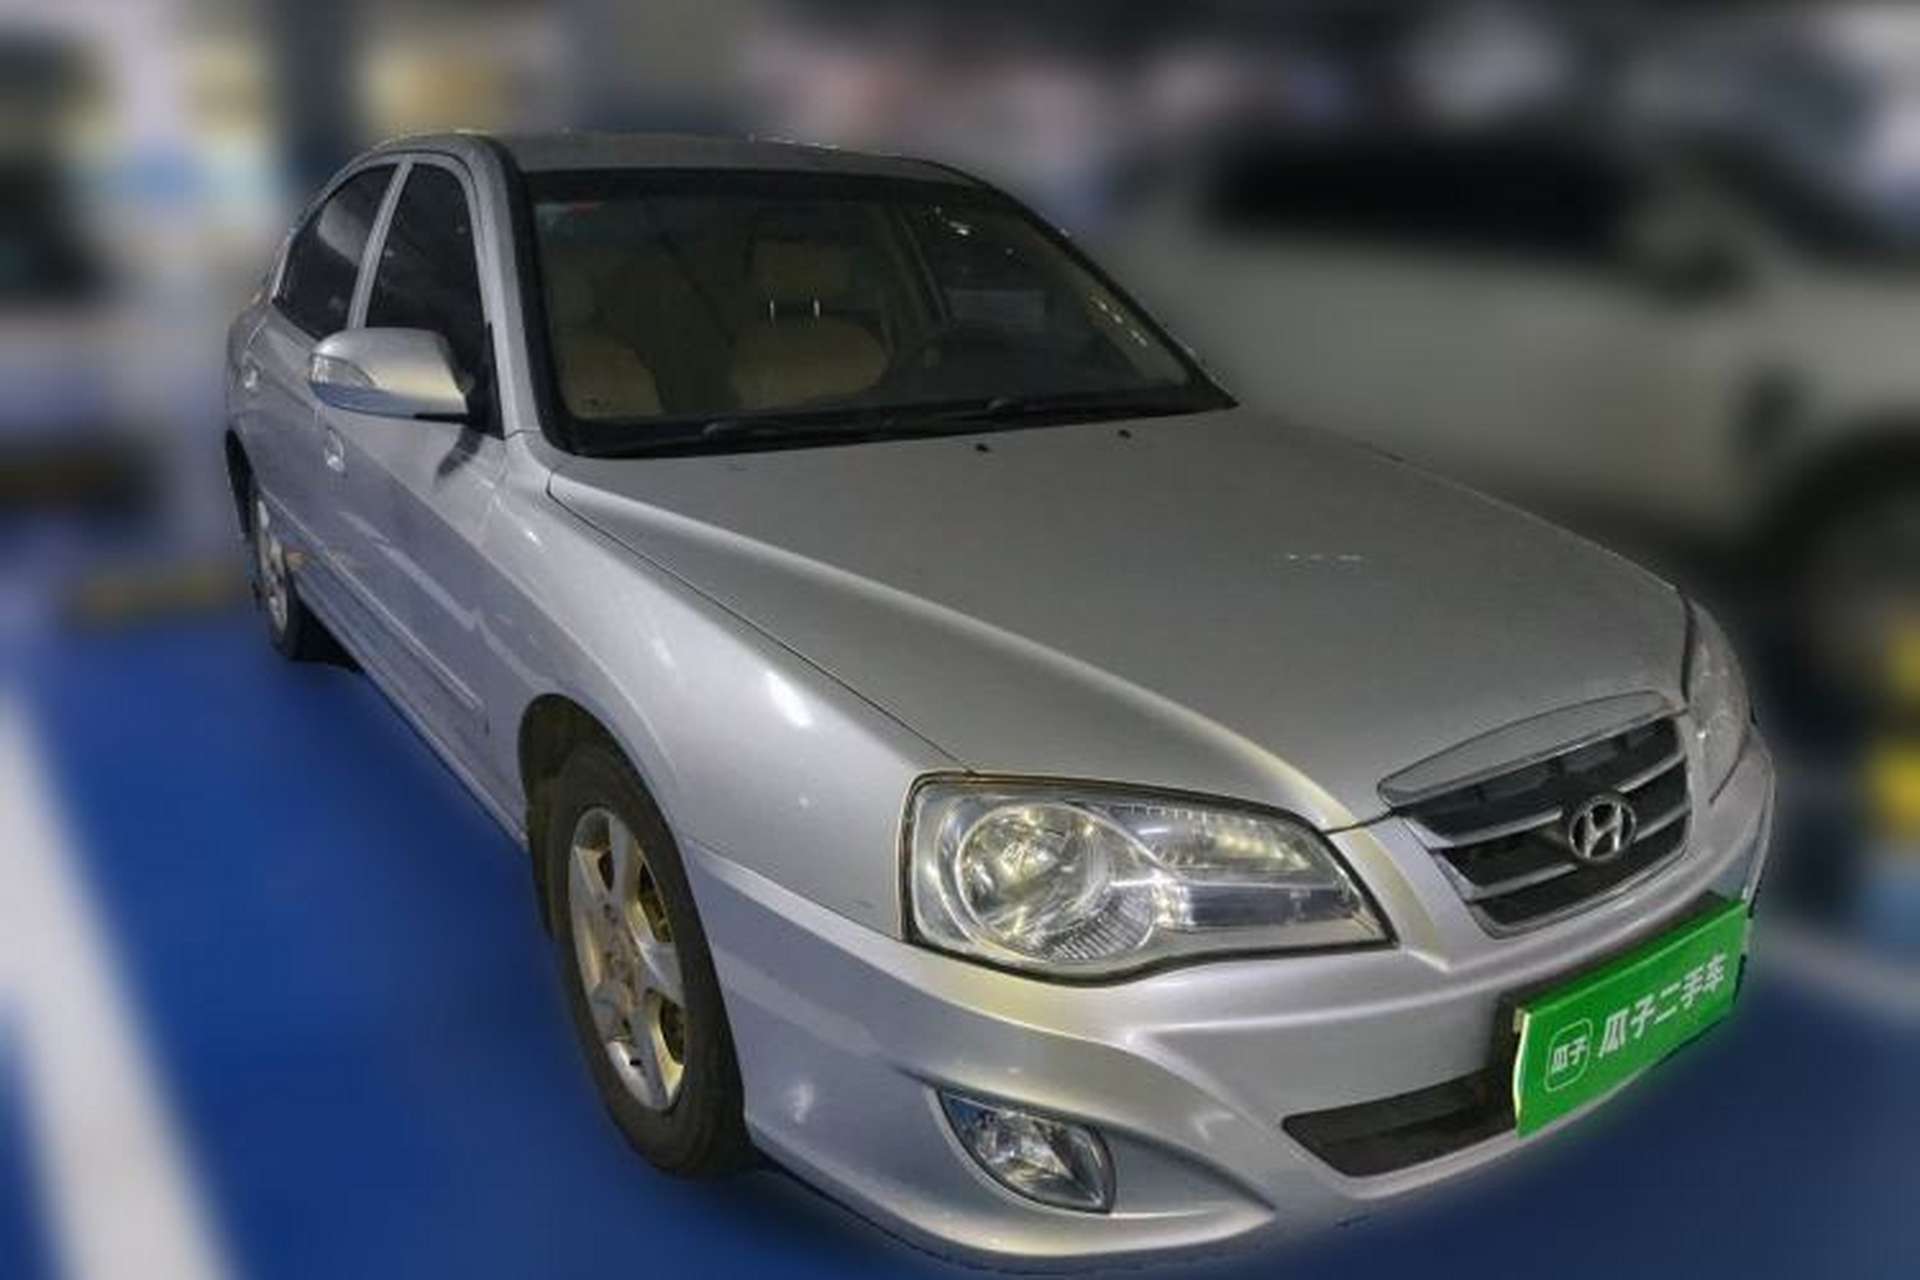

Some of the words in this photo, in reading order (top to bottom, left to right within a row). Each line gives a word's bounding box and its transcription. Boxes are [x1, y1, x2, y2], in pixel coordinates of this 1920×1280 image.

[1599, 953, 1727, 1058] 瓜子二手车
[1551, 1035, 1589, 1074] 瓜子
